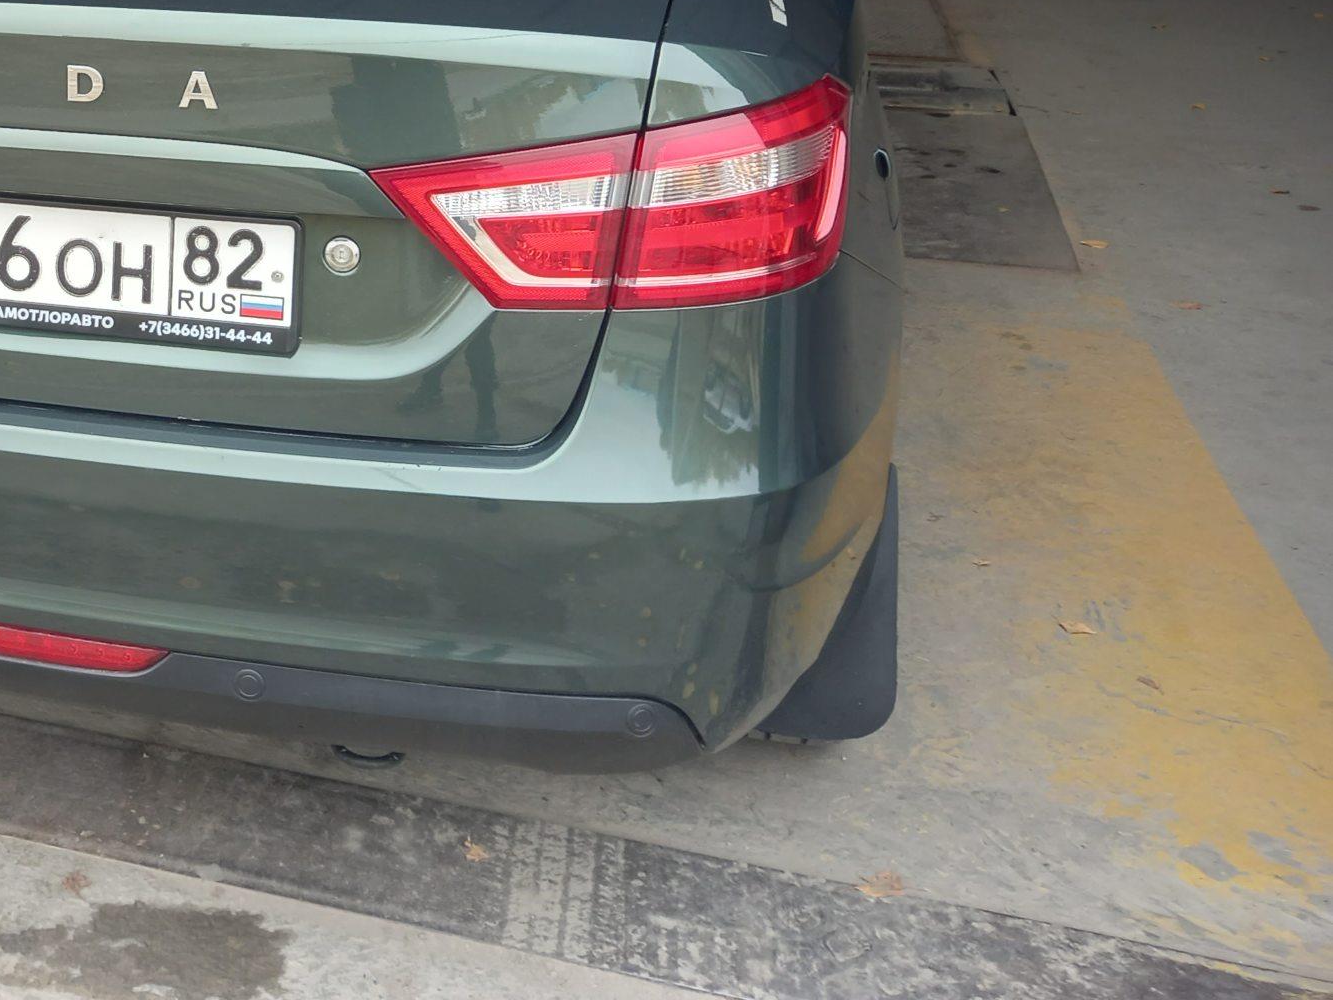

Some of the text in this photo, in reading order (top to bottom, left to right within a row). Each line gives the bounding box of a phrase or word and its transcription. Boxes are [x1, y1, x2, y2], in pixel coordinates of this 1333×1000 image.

[182, 225, 264, 291] 82
[177, 289, 237, 316] RUS
[138, 319, 273, 346] +7(3466)31-44-44
